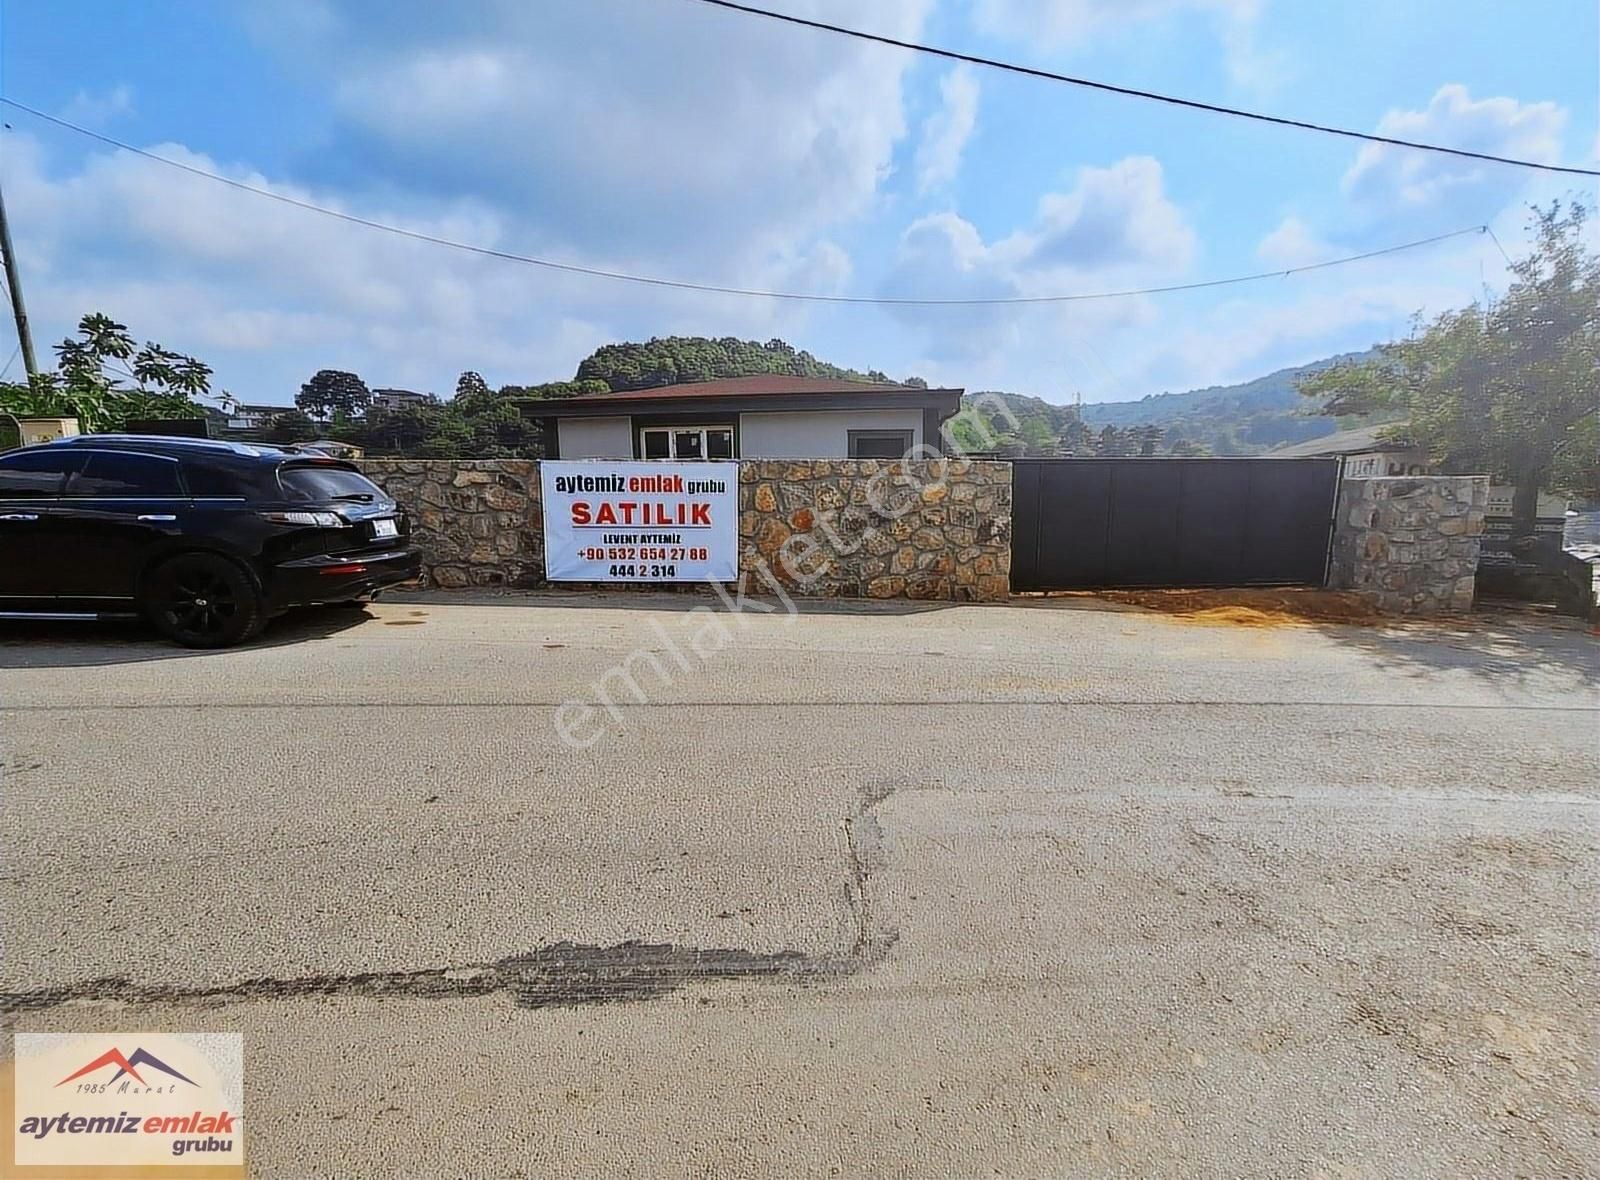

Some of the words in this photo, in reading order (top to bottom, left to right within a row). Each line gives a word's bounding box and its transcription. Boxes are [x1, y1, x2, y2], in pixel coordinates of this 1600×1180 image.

[555, 474, 625, 495] aytemiz
[629, 474, 684, 493] emlak
[688, 479, 726, 495] grubu
[571, 502, 712, 525] SATILIK
[603, 534, 639, 545] LEVENT
[640, 532, 681, 545] AYTEMİZ
[577, 548, 604, 561] +90
[608, 548, 636, 561] 532
[640, 548, 666, 561] 654
[670, 548, 686, 561] 27
[609, 565, 635, 578] 444
[639, 565, 649, 578] 2
[651, 565, 676, 578] 314
